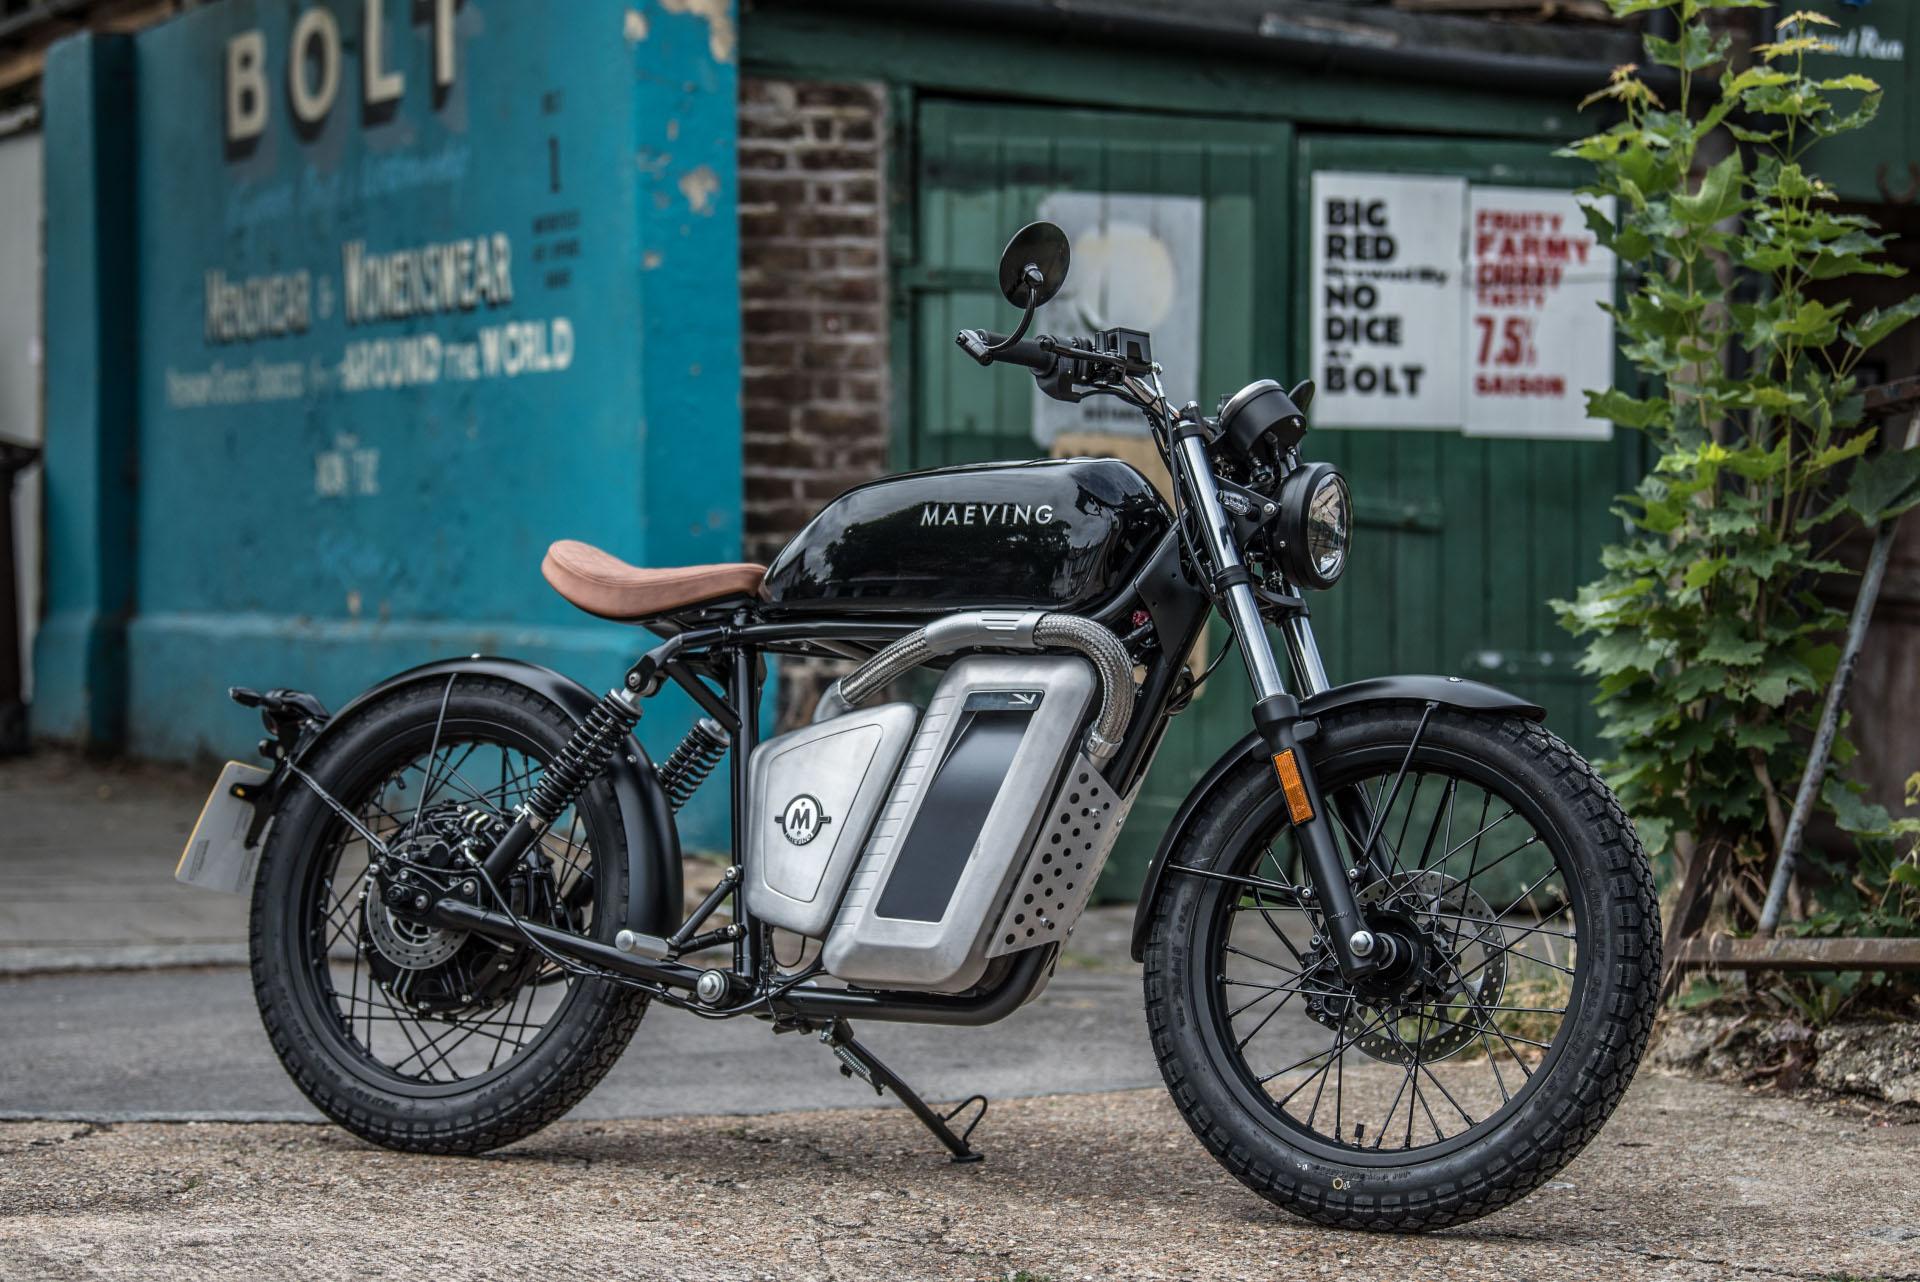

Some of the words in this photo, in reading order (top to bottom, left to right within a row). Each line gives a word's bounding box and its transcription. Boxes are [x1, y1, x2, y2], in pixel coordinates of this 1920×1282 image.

[226, 0, 456, 144] BOLT
[1326, 199, 1387, 227] BIG
[1326, 234, 1397, 261] RED
[1326, 285, 1378, 311] NO
[1326, 316, 1402, 344] DICE
[478, 317, 574, 377] WORLD
[1325, 364, 1426, 396] BOLT
[920, 504, 1054, 527] MAEVING
[790, 808, 811, 830] M
